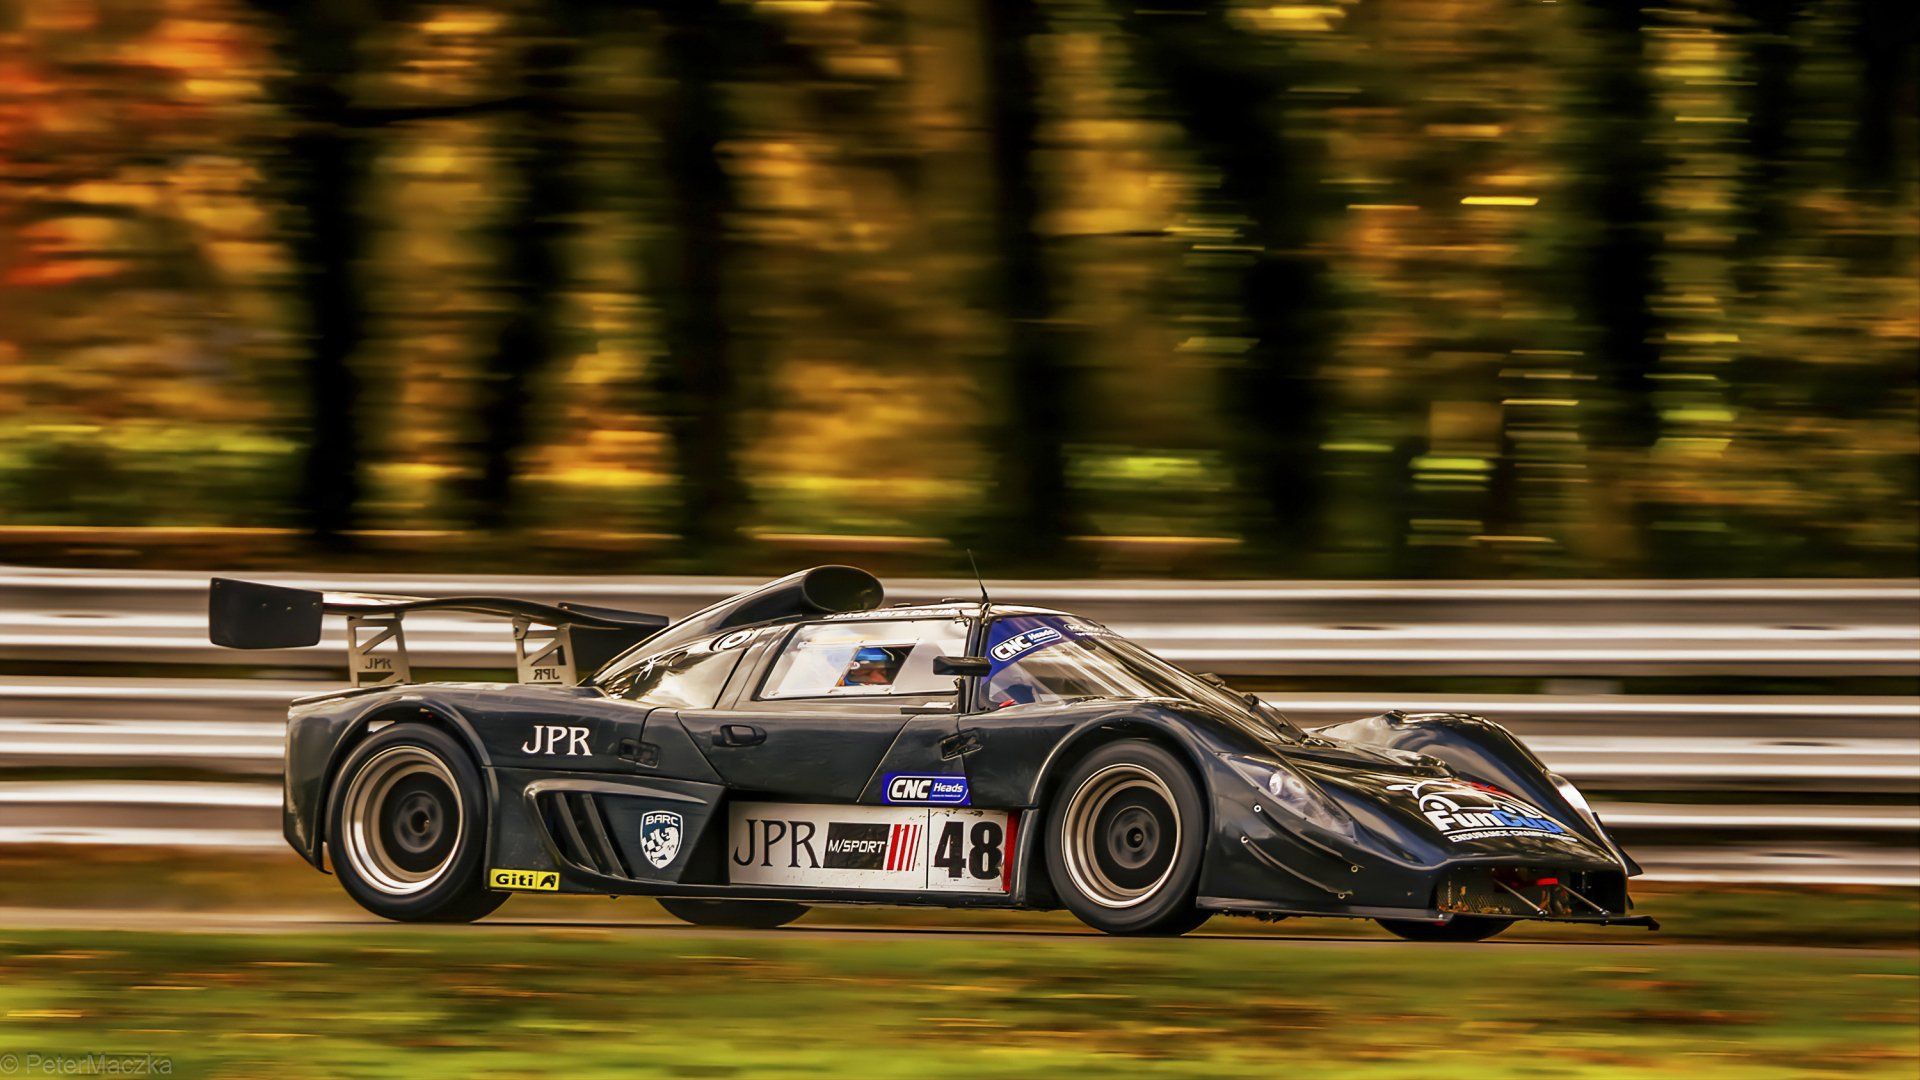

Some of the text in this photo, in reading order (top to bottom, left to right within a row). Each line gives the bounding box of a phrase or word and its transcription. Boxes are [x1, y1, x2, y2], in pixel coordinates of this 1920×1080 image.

[994, 635, 1032, 659] CNC
[521, 725, 593, 756] JPR
[890, 779, 964, 799] CNC Heads
[645, 813, 679, 827] BARC
[732, 818, 886, 869] JPR M/SPORT
[930, 820, 1004, 881] 48
[494, 873, 534, 887] Giti
